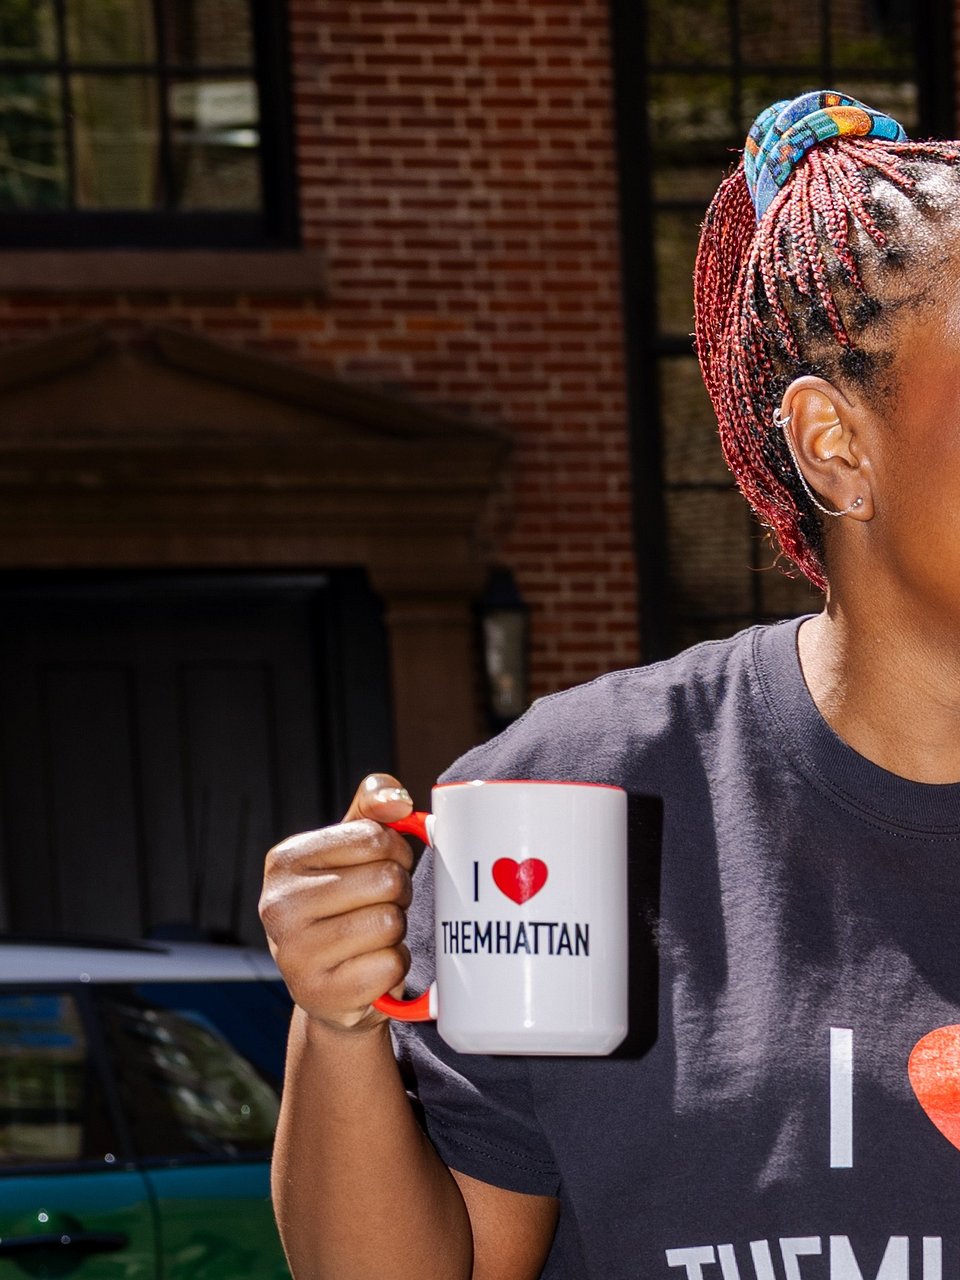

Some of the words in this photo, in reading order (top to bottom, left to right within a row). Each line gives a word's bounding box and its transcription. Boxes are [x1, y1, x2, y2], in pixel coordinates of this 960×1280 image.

[473, 860, 479, 902] I
[441, 920, 590, 956] THEMHATTAN
[829, 1026, 854, 1168] I
